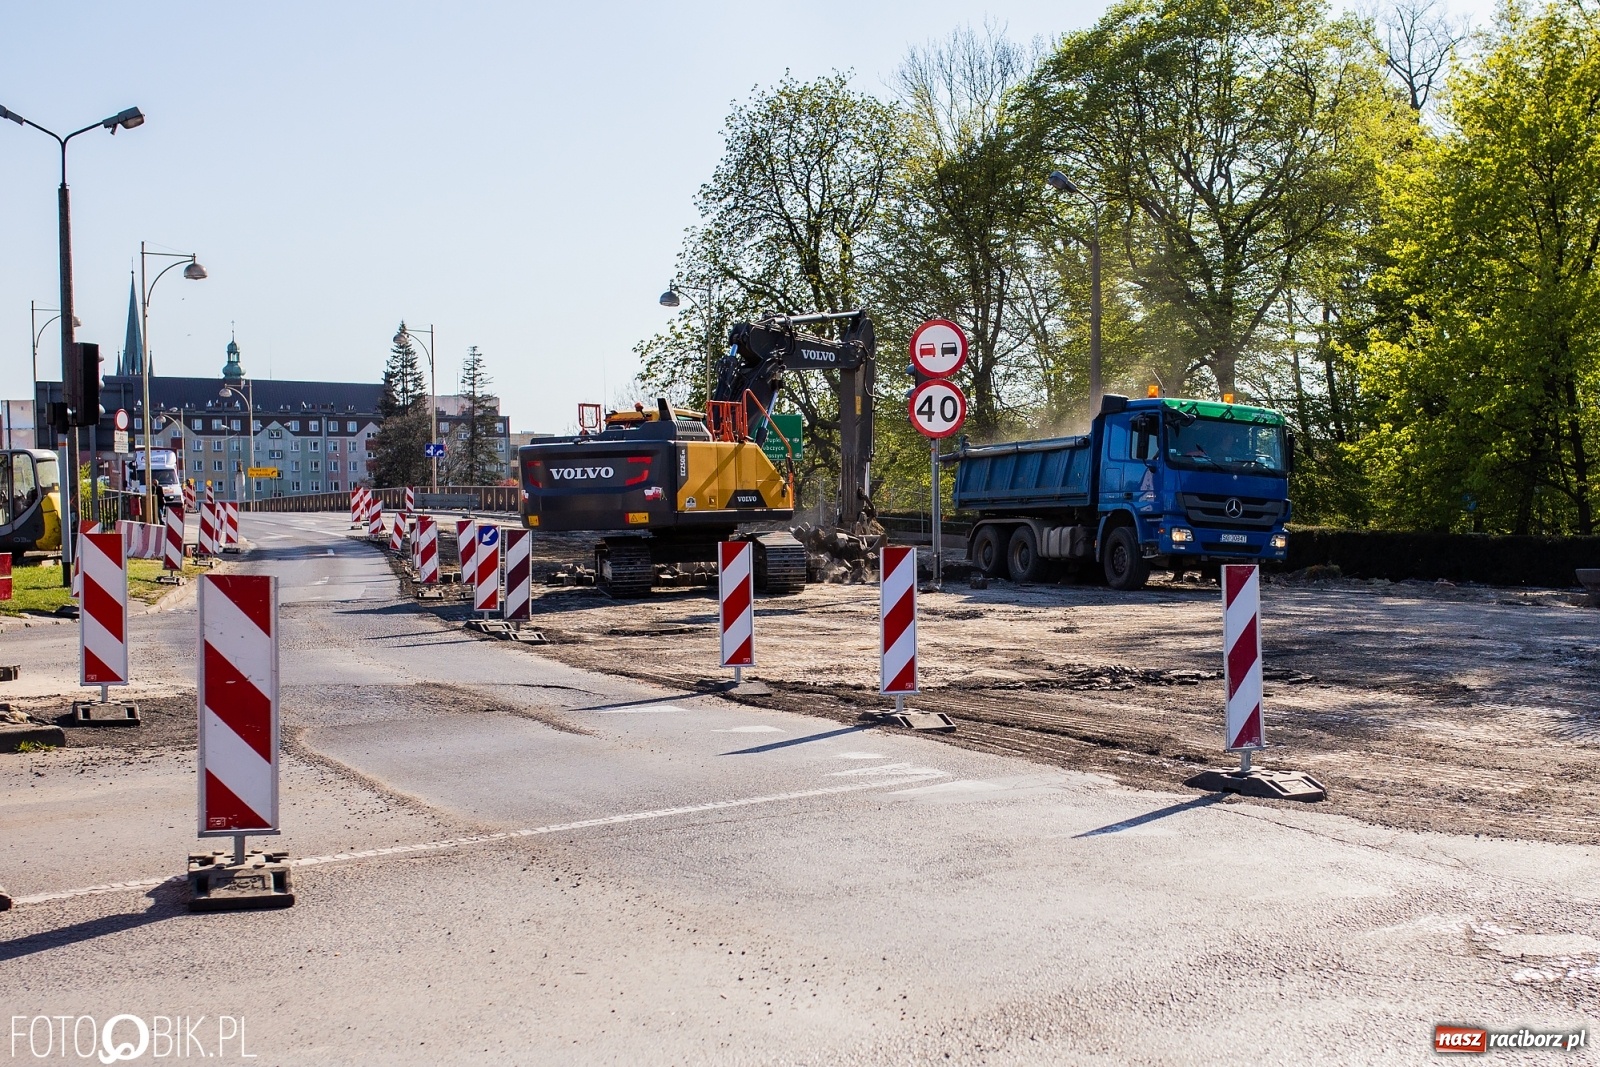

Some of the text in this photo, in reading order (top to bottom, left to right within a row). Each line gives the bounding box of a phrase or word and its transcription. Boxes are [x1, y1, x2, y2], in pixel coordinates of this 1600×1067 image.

[801, 349, 836, 362] VOLVO
[917, 395, 958, 423] 40
[762, 444, 785, 452] ubczyce
[550, 466, 614, 480] VOLVO
[737, 495, 757, 503] VOLVO
